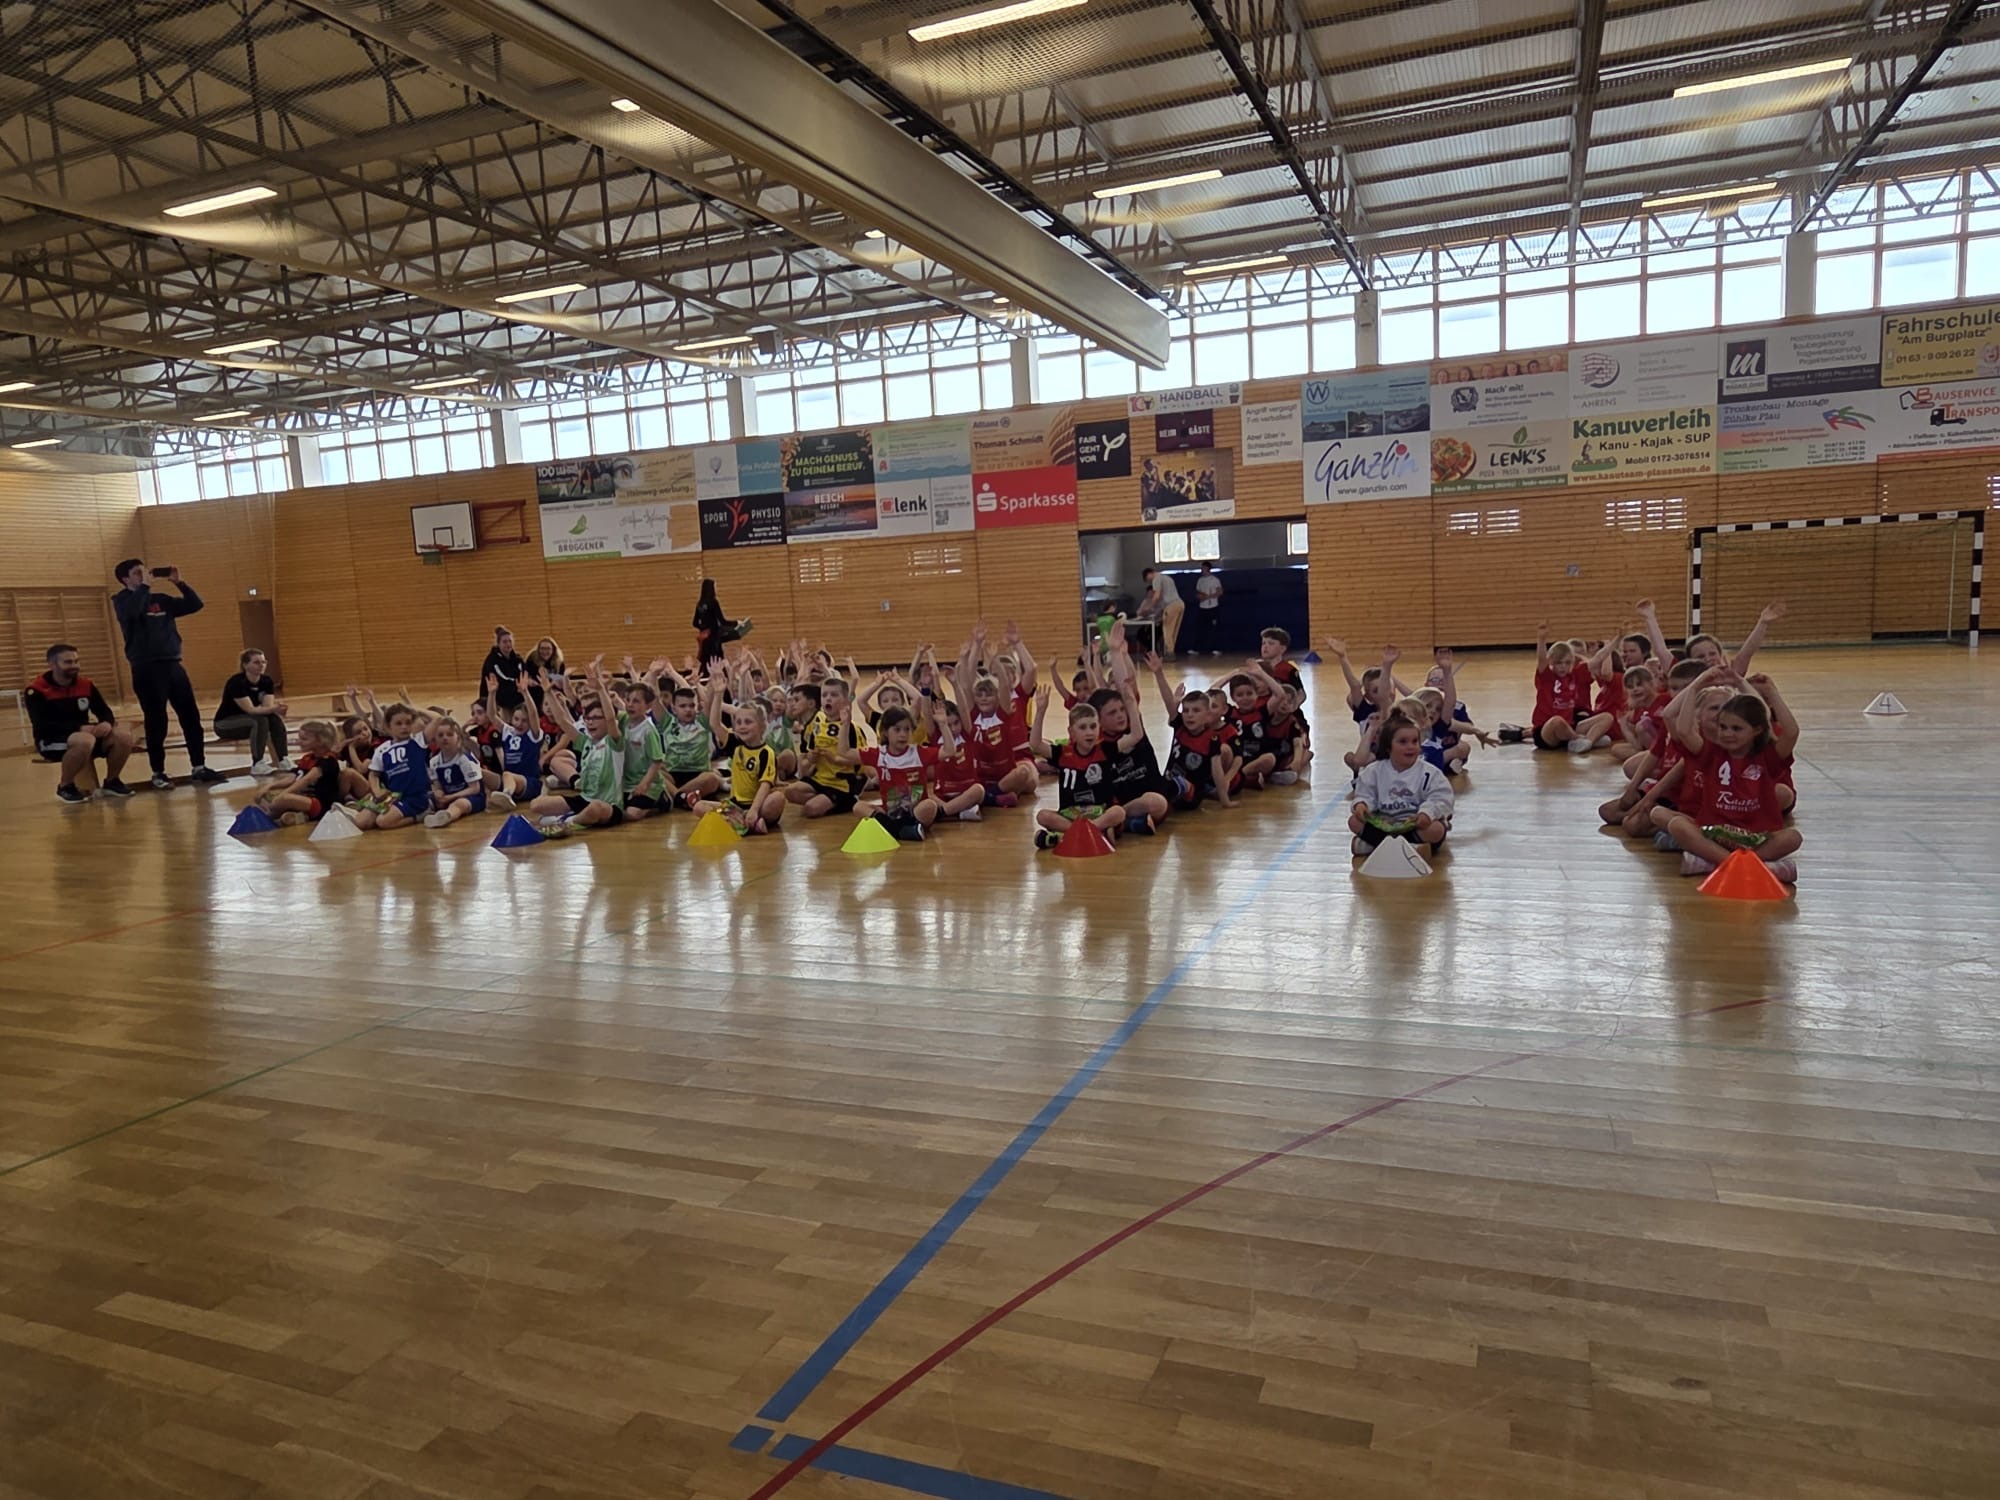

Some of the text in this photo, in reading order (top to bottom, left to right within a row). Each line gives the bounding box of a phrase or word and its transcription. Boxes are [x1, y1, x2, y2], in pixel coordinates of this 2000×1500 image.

[1886, 309, 2000, 335] Fahrschule
[1159, 387, 1222, 403] HANDBALL
[1582, 398, 1617, 408] AHRENS
[1573, 408, 1711, 439] Kanuverleih
[1758, 411, 1781, 420] Plau
[1188, 424, 1211, 435] GÄSTE
[974, 435, 1043, 449] Thomas Schmidt
[1079, 435, 1097, 444] FAIR
[1599, 440, 1629, 451] Kanu
[1640, 436, 1673, 449] Kajak
[1684, 432, 1711, 443] SUP
[1080, 445, 1101, 454] GEHT
[1489, 448, 1547, 467] LENK'S
[795, 452, 859, 467] MACH GENUSS
[1079, 454, 1097, 464] VOR
[1625, 456, 1650, 465] Mobil
[538, 466, 555, 478] 100
[791, 461, 866, 478] ZU DEINEM BERUF.
[1314, 440, 1419, 501] Ganzlin
[895, 494, 928, 513] lenk
[1000, 492, 1076, 513] Sparkasse
[704, 512, 728, 525] SPORT
[751, 506, 781, 520] PHYSIO
[1880, 695, 1891, 712] 4
[827, 723, 840, 737] 8
[1236, 719, 1244, 736] 3
[388, 746, 406, 764] 10
[745, 756, 756, 772] 6
[1063, 768, 1077, 790] 11
[1718, 760, 1731, 786] 4
[1423, 772, 1430, 791] 1
